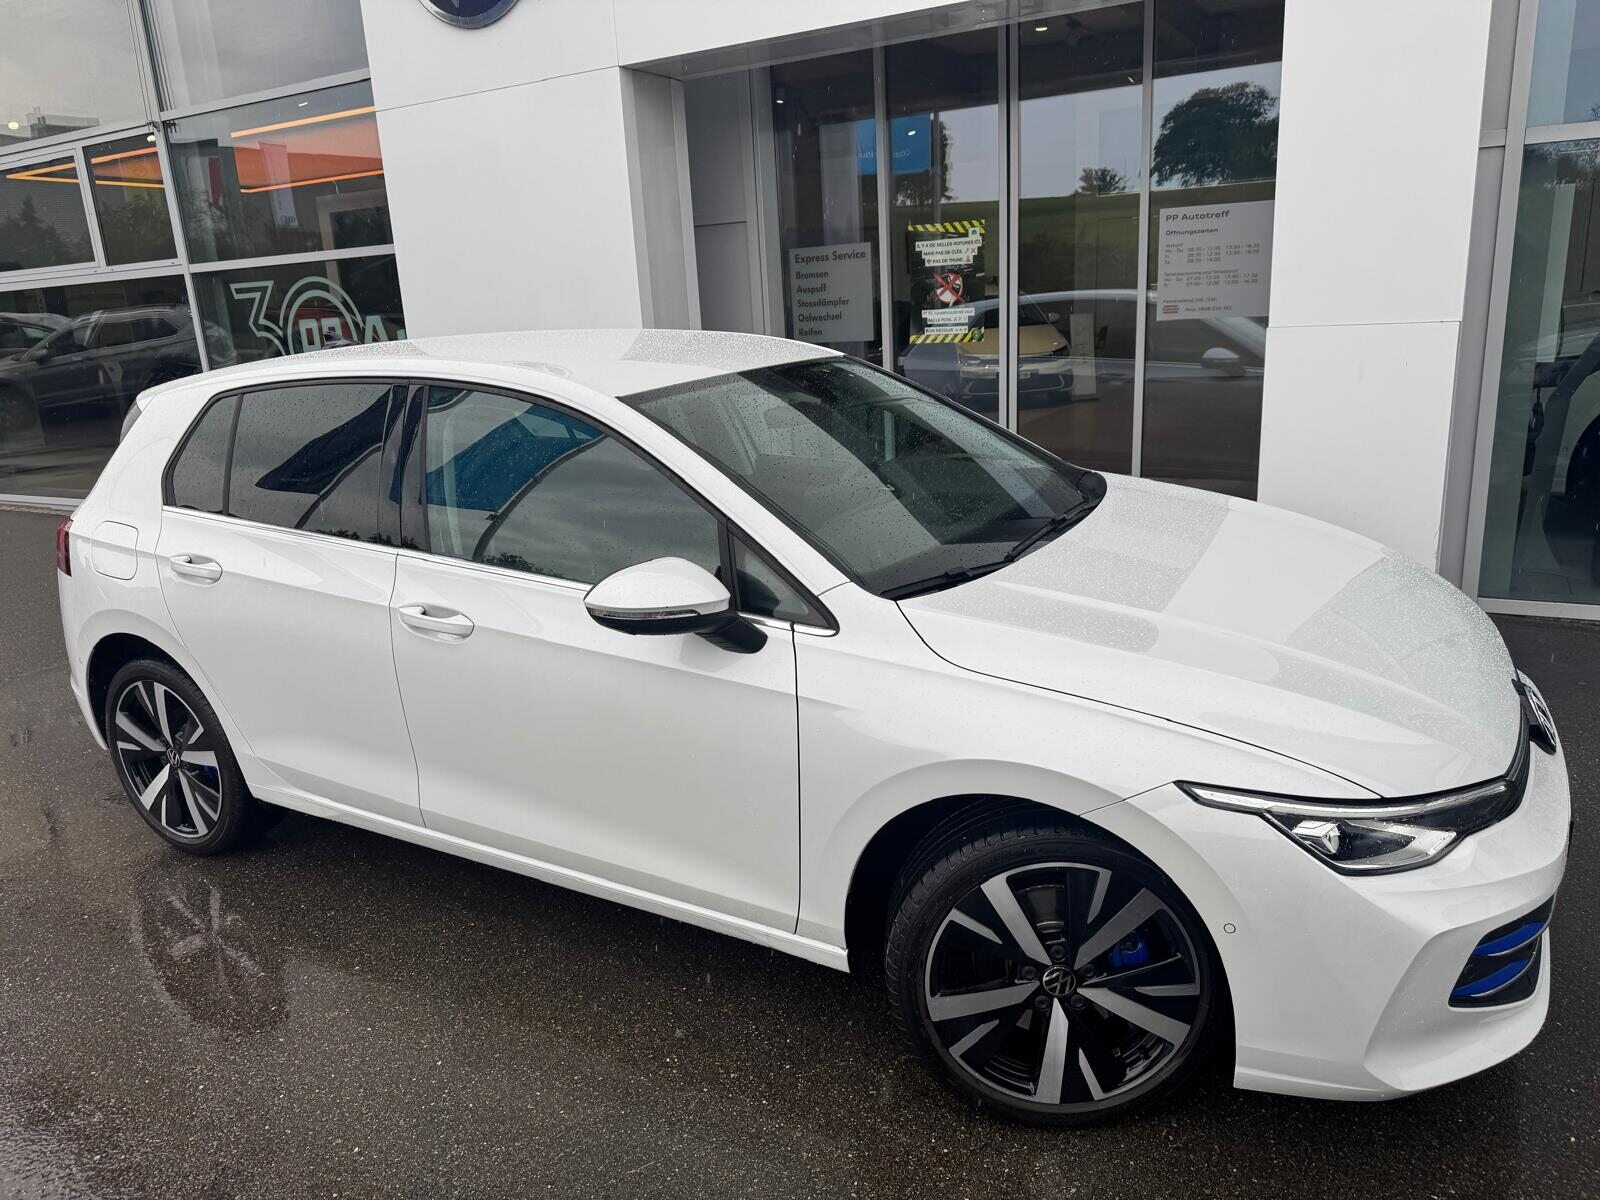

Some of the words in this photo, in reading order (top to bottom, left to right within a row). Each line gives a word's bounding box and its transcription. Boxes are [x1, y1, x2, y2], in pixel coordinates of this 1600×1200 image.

[1182, 210, 1230, 220] Autotreff
[1166, 228, 1218, 236] Öffnungszeiten
[795, 254, 829, 265] Express
[832, 250, 866, 261] Service
[796, 272, 829, 280] Bremsen
[797, 283, 826, 294] Auspuff
[797, 297, 850, 308] Stossdämpfer
[798, 311, 842, 322] Oelwechsel
[799, 328, 822, 336] Reifen
